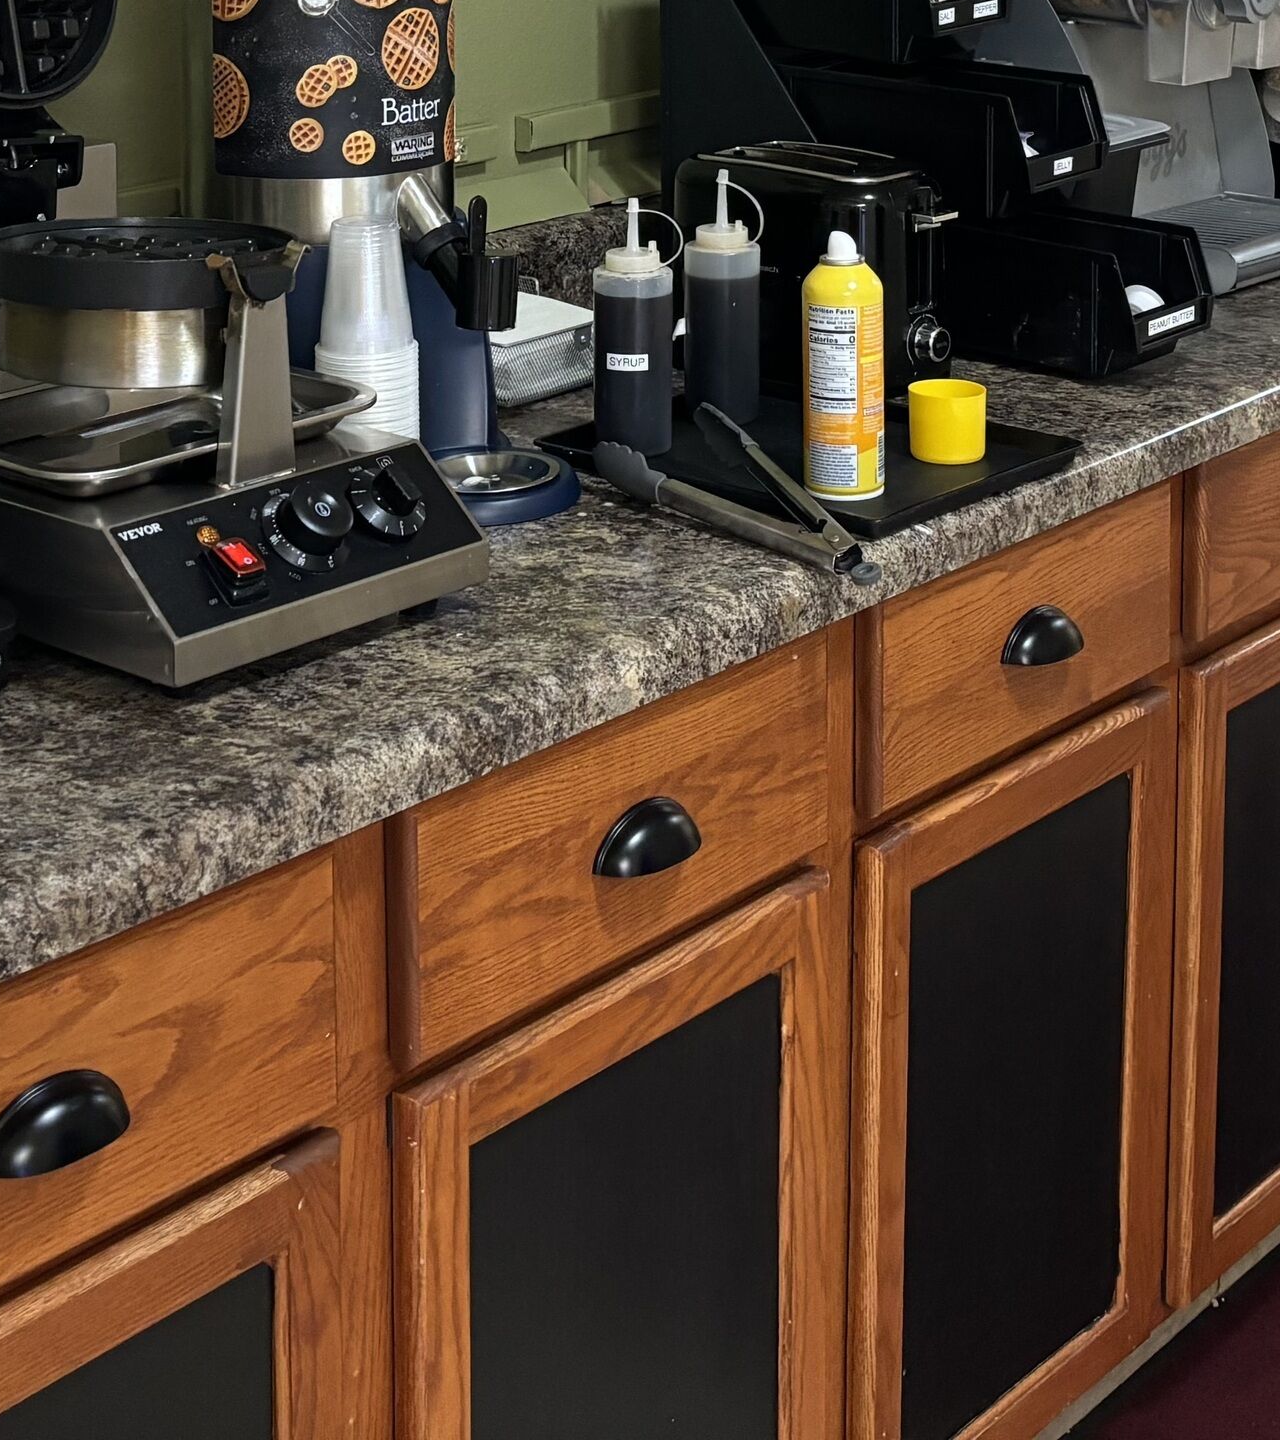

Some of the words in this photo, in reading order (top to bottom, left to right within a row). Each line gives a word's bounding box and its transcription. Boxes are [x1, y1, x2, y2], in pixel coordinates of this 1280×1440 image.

[940, 12, 953, 21] SALT
[976, 3, 996, 14] PEPPER
[381, 98, 440, 126] Batter
[394, 135, 432, 153] WARING
[1150, 318, 1171, 332] PEANUT
[1172, 310, 1194, 324] BUTTER
[810, 334, 838, 344] Calories
[609, 357, 646, 368] SYRUP
[118, 522, 163, 544] VEVOR
